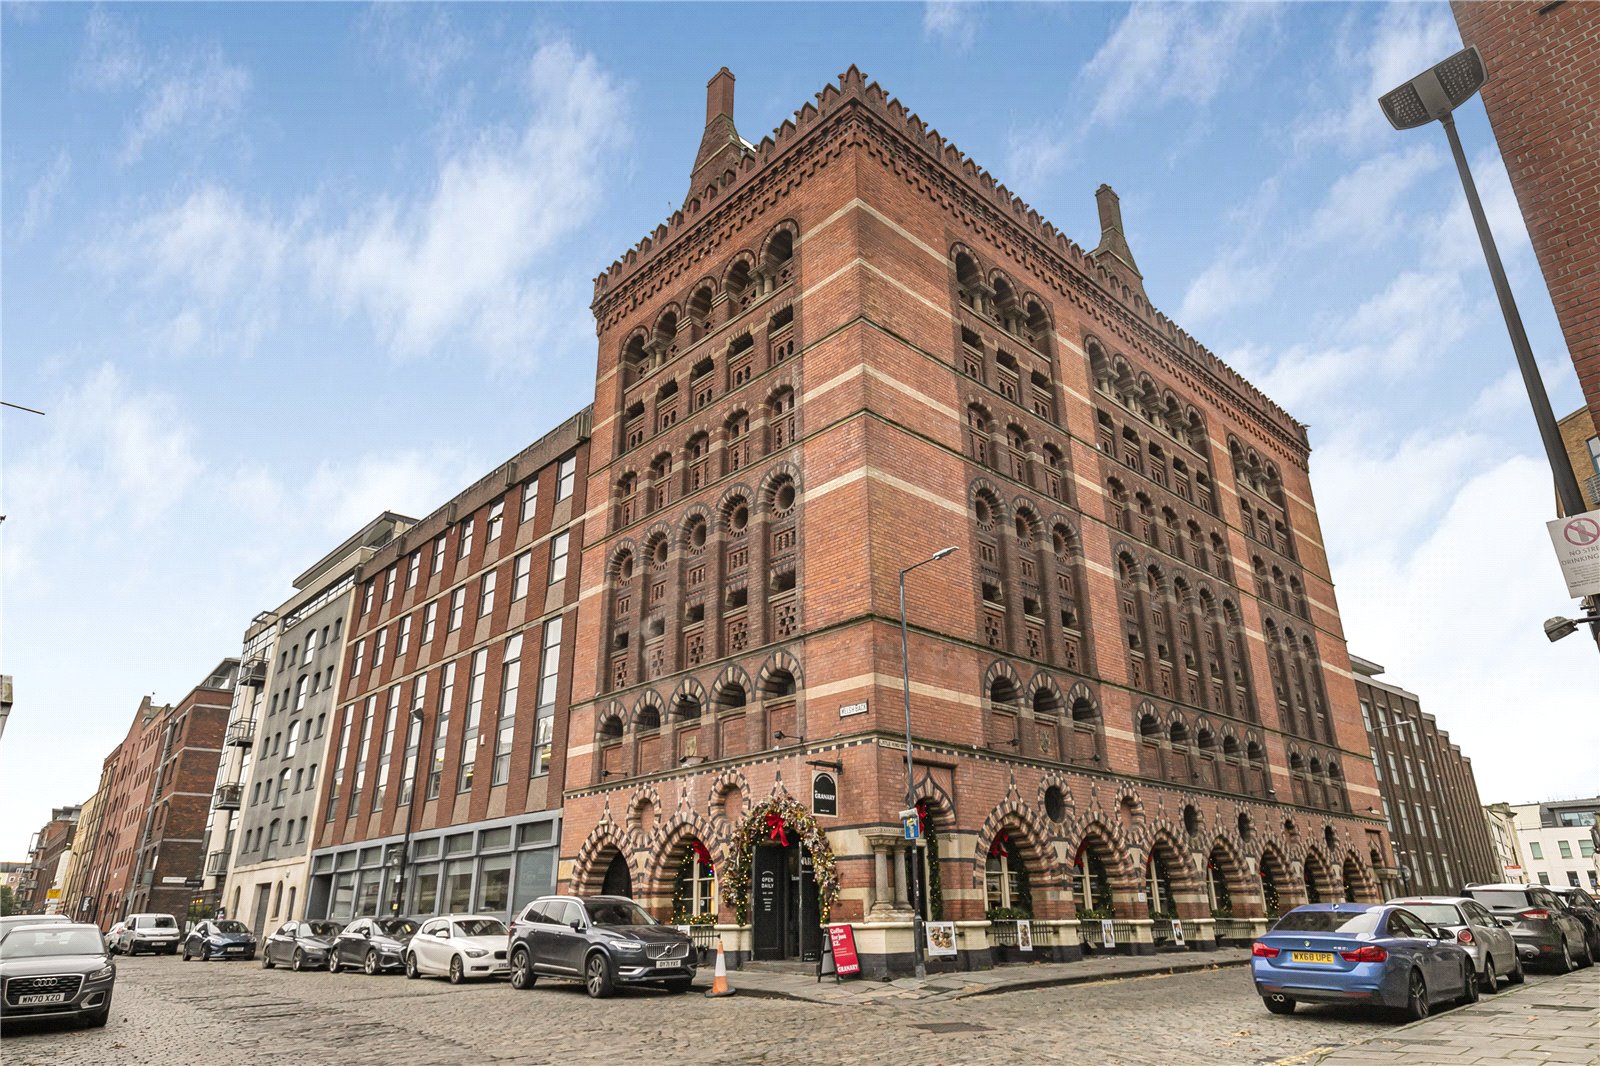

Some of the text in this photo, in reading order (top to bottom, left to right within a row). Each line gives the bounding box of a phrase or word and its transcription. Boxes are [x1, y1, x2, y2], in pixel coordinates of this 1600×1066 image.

[1561, 553, 1599, 566] DRINKING
[1316, 953, 1332, 962] UPE
[837, 964, 858, 972] GRANARY
[22, 995, 44, 1003] WN70
